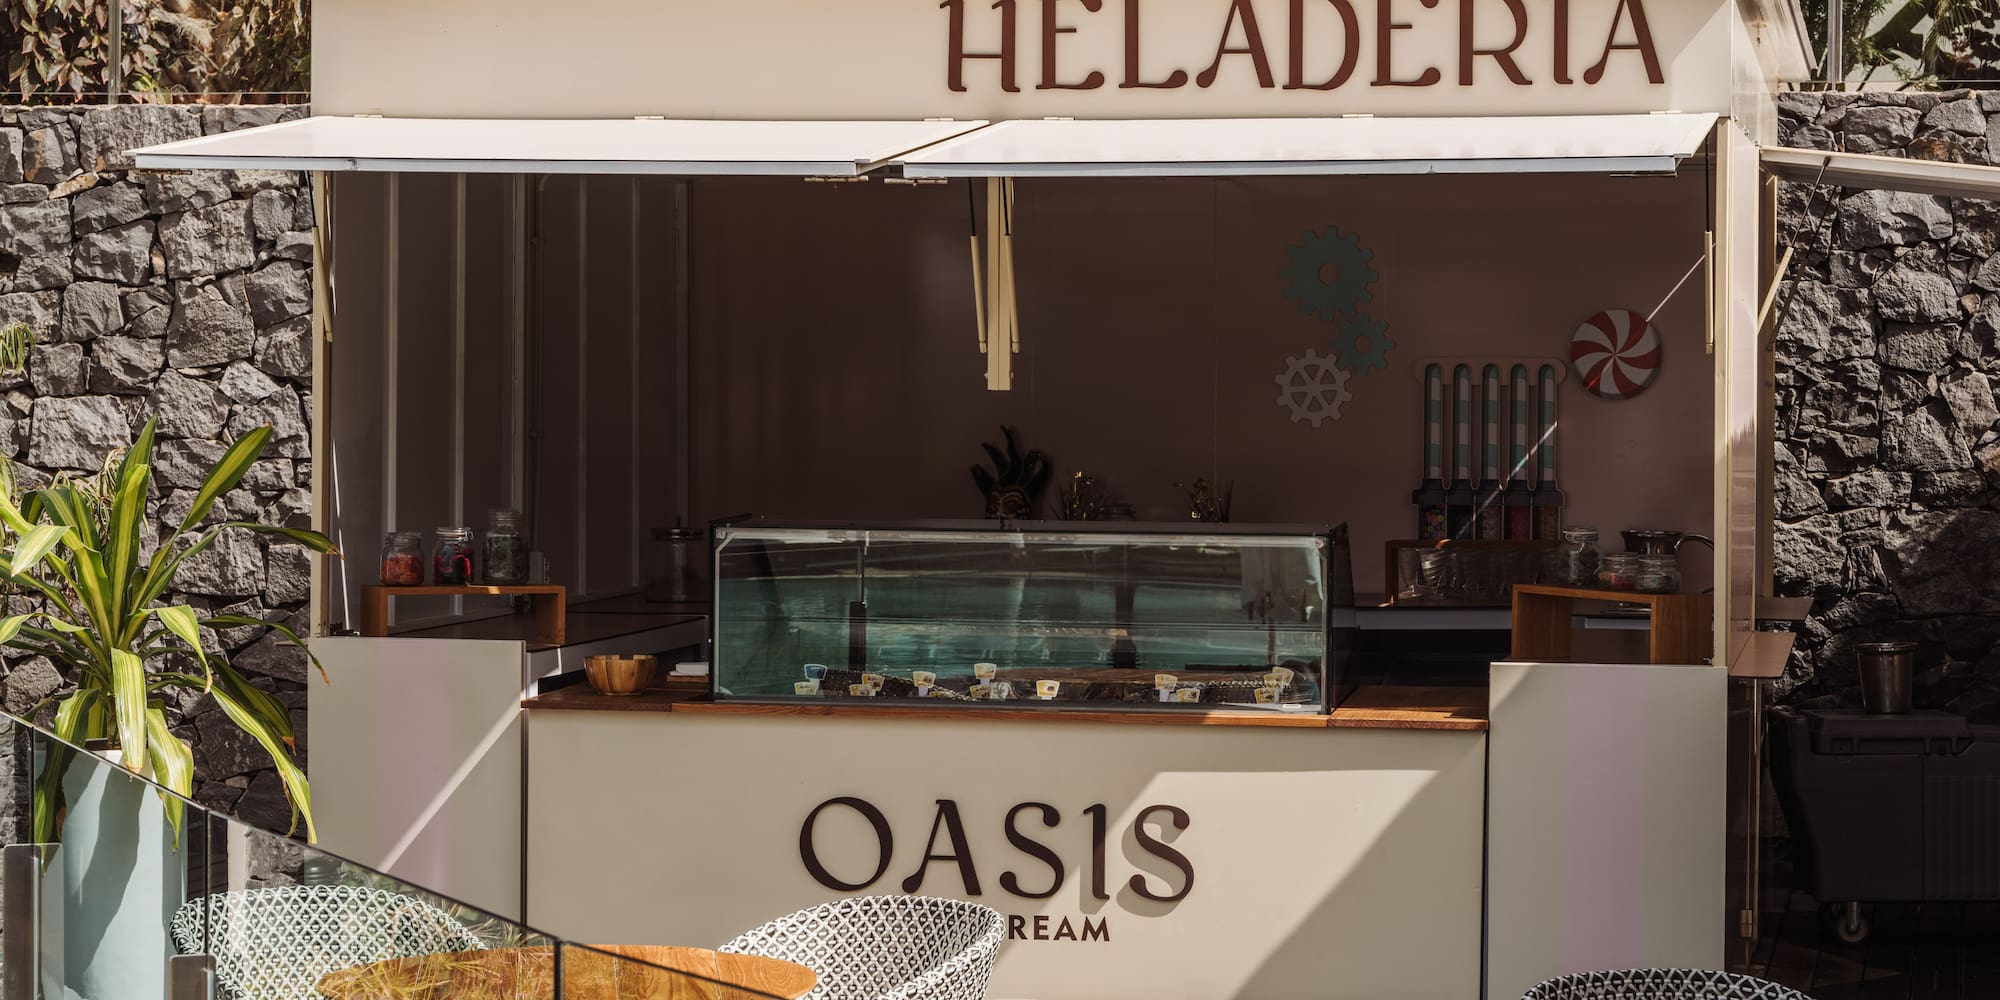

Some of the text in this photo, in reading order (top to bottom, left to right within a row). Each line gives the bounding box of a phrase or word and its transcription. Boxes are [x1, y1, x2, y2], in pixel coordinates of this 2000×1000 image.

[939, 0, 1665, 93] HELADERIA
[799, 796, 1195, 902] OASIS
[1007, 914, 1111, 943] REAM
